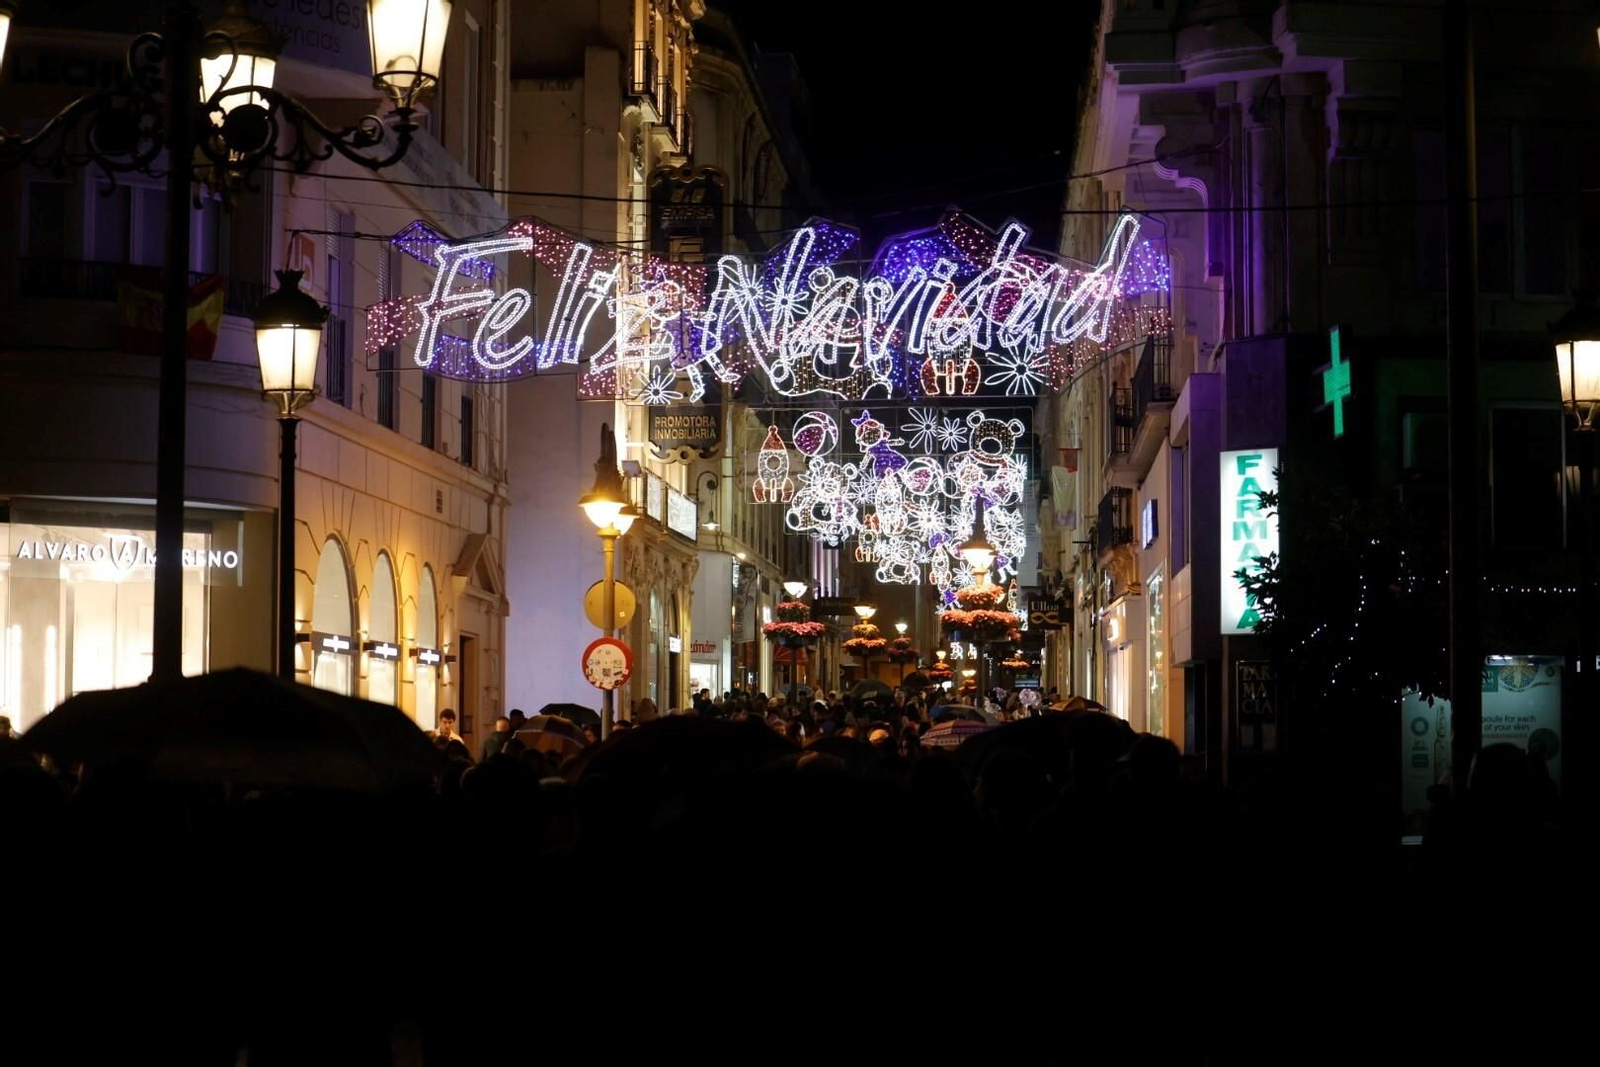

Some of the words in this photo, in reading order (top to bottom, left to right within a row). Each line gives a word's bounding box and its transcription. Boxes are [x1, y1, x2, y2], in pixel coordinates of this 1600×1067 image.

[414, 236, 674, 376] Feliz
[700, 214, 1140, 382] Navidad
[654, 415, 717, 428] PROMOTORA
[654, 428, 717, 440] INMOBILIARIA
[17, 540, 104, 562] ALVARO
[143, 545, 239, 569] MRENO
[1504, 715, 1516, 723] for
[1517, 715, 1536, 723] each
[1483, 723, 1493, 731] of
[1513, 723, 1530, 731] skin
